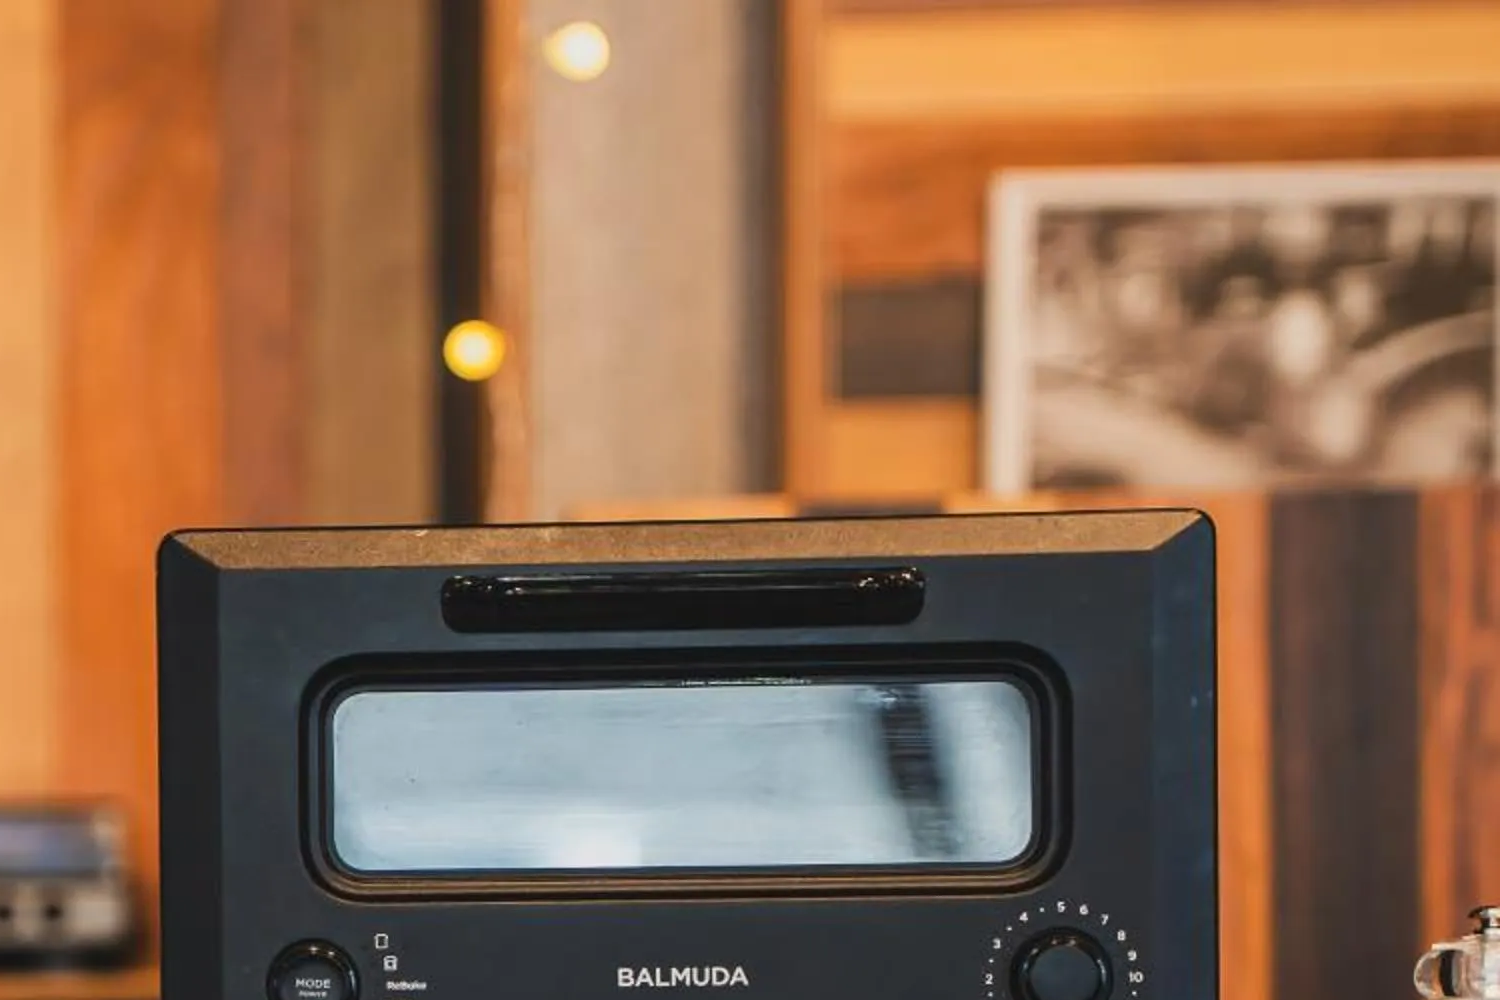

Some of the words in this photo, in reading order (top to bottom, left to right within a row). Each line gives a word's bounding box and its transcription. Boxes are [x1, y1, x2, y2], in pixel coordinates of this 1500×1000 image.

[1056, 901, 1066, 913] 5
[1079, 904, 1089, 916] 6
[1019, 911, 1029, 922] 4
[1101, 913, 1109, 926] 7
[1117, 929, 1126, 941] 8
[993, 938, 1002, 950] 3
[1127, 950, 1138, 962] 9
[617, 966, 749, 987] BALMUDA
[985, 973, 994, 985] 2
[1128, 971, 1144, 983] 10
[295, 978, 331, 989] MODE
